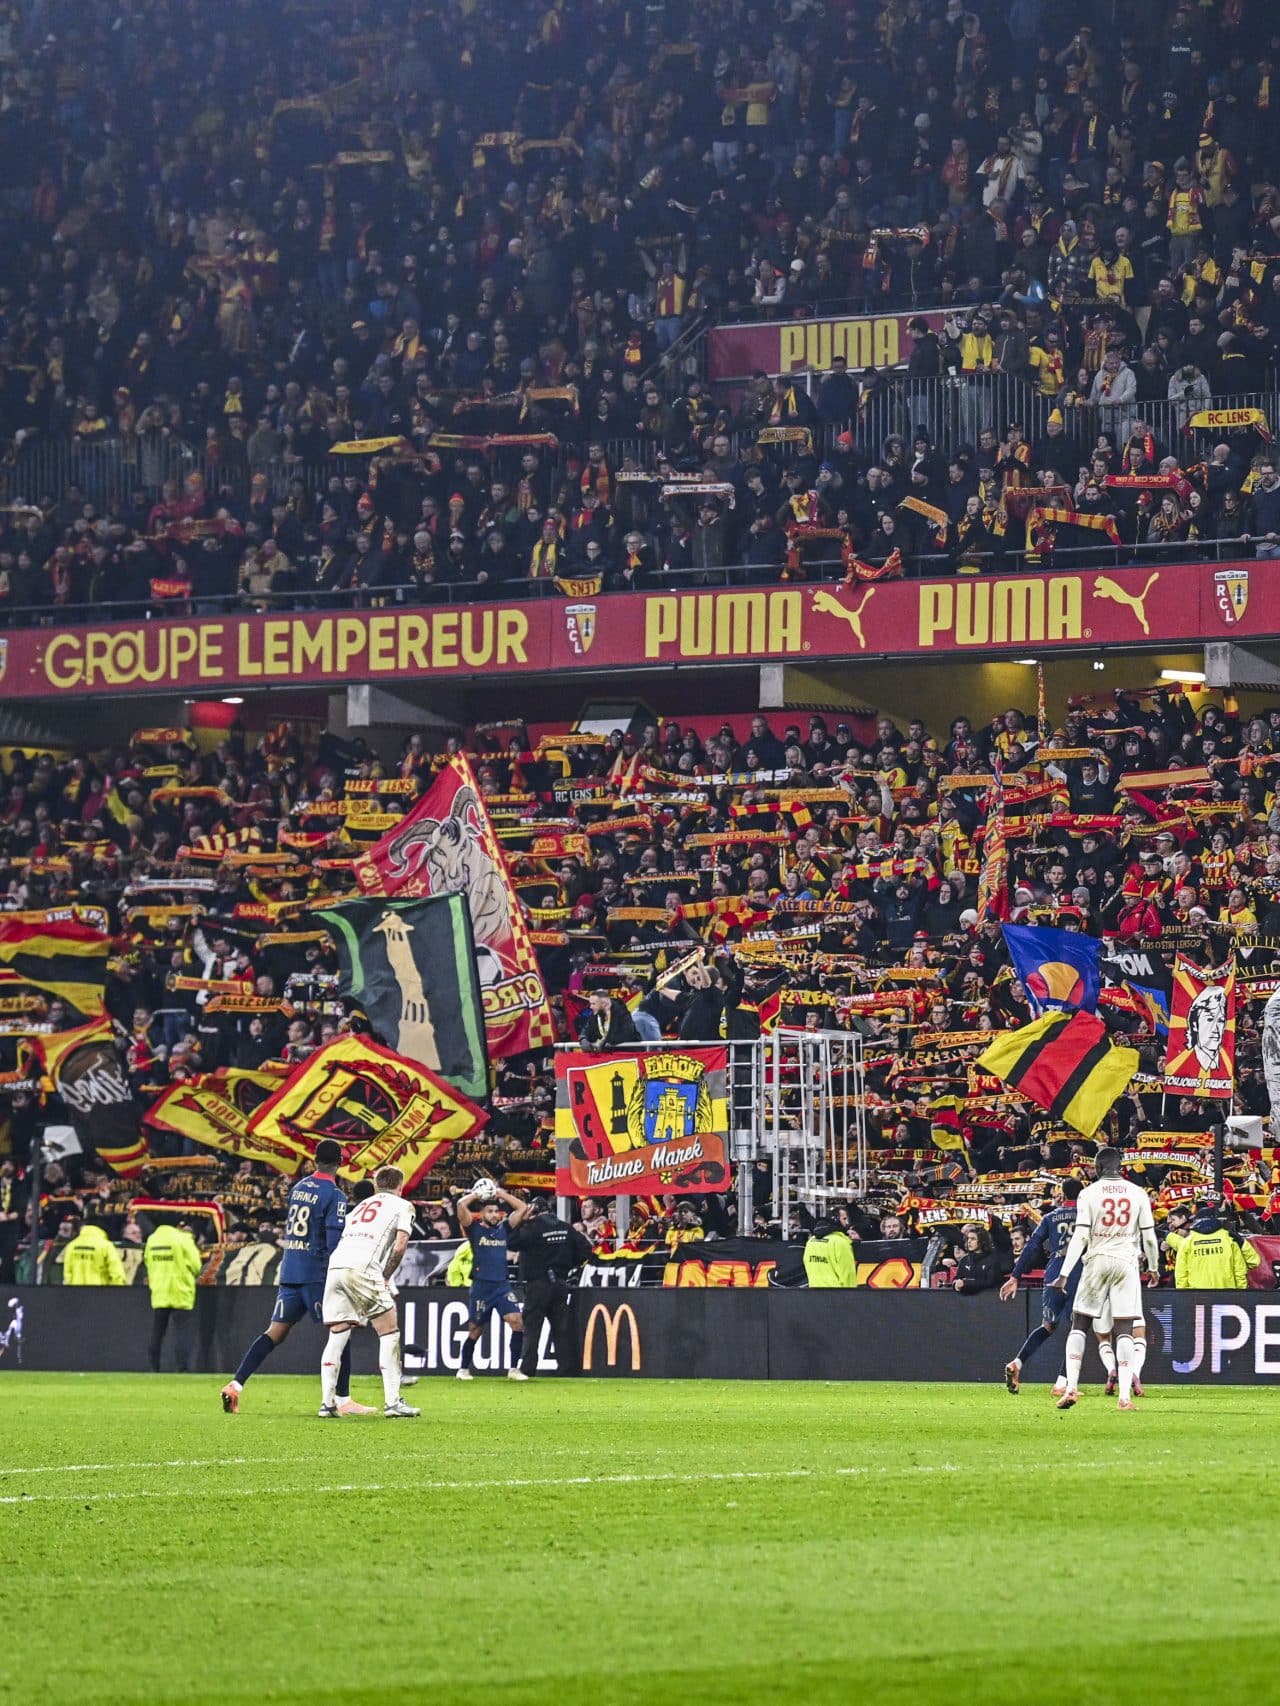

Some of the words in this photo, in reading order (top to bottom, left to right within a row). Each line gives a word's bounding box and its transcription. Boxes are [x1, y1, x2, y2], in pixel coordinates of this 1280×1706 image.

[780, 318, 899, 373] PUMA
[1208, 411, 1223, 424] RC
[1226, 410, 1250, 423] LENS
[570, 581, 596, 597] LENS
[919, 576, 1081, 646] PUMA
[645, 591, 802, 657] PUMA
[44, 624, 224, 688] GROUPE
[238, 609, 529, 677] LEMPEREUR
[555, 790, 568, 802] RC
[569, 788, 592, 802] LENS
[307, 800, 338, 813] SANG
[238, 904, 268, 917] SANG
[747, 930, 775, 942] LENS
[1164, 1077, 1202, 1088] TOUJOURS
[304, 1078, 350, 1121] RCL
[456, 1151, 493, 1162] SAINTE
[586, 1158, 644, 1185] Tribune
[650, 1135, 704, 1170] Marek
[1141, 1151, 1152, 1161] DE
[1152, 1151, 1169, 1162] NOS
[537, 1176, 556, 1186] LEN
[957, 1184, 993, 1193] DEVILS
[1007, 1184, 1035, 1192] LENS
[1102, 1185, 1128, 1194] MENDY
[919, 1208, 948, 1222] LENS
[963, 1207, 990, 1223] FANS
[1101, 1198, 1131, 1227] 33
[1193, 1247, 1224, 1258] STEWARD
[476, 1299, 486, 1312] 14
